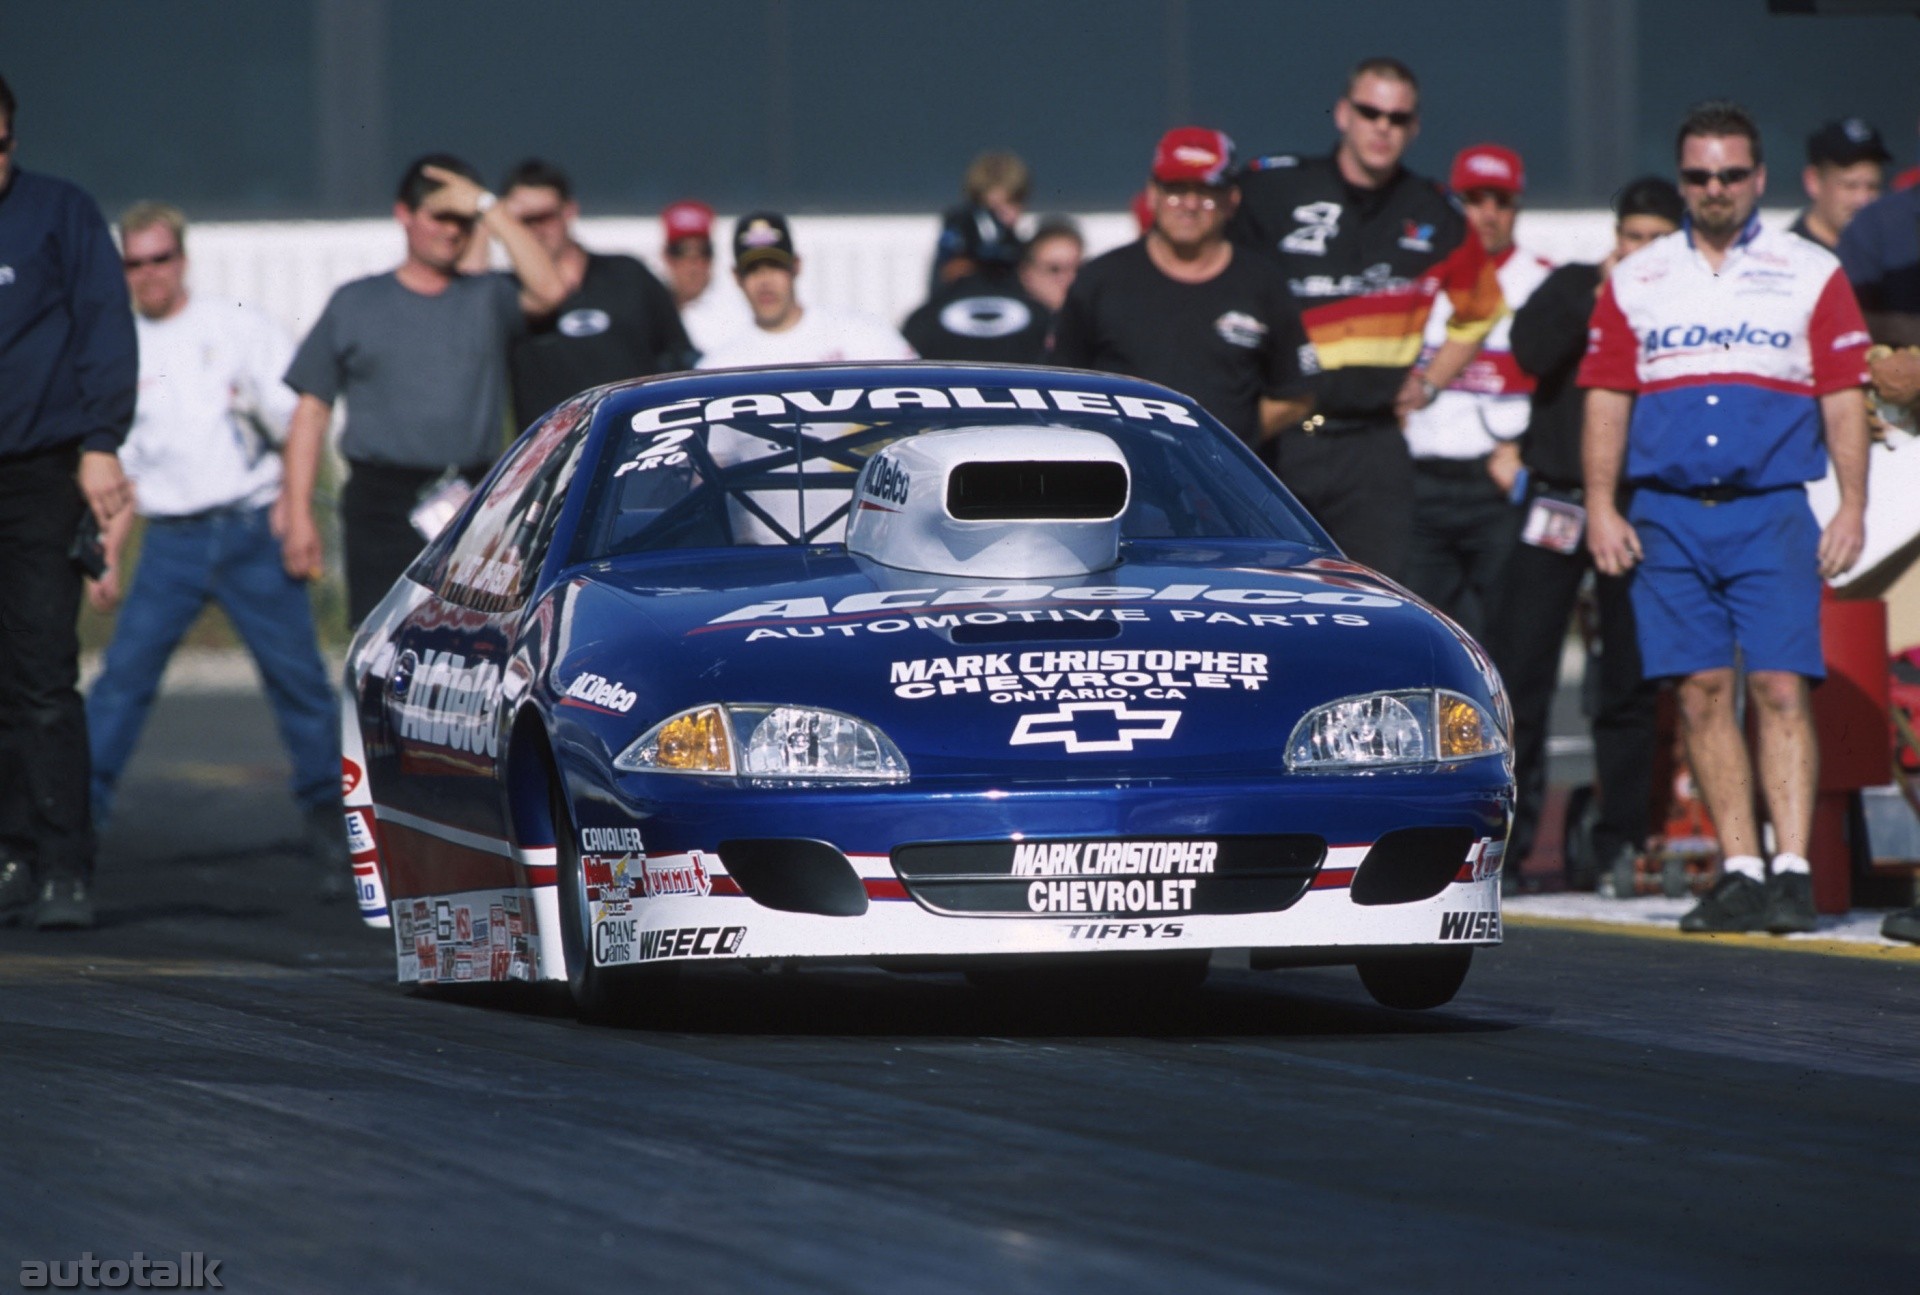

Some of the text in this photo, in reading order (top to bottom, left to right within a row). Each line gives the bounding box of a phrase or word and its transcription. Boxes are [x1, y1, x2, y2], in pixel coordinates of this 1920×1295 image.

[631, 387, 1199, 433] CAVALIER
[636, 428, 694, 460] 2
[613, 451, 688, 478] PRO
[863, 454, 910, 505] ACDelco
[707, 584, 1402, 625] ACDelco
[745, 608, 1370, 642] AUTOMOTIVE PARTS
[890, 650, 1269, 684] MARK CHRISTOPHER
[565, 671, 637, 713] ACDelco
[894, 672, 1269, 700] CHEVROLET
[990, 687, 1187, 704] ONTARIO, CA
[582, 827, 644, 851] CAVALIER
[1011, 841, 1217, 876] MARK CHRISTOPHER
[1027, 879, 1196, 912] CHEVROLET
[640, 926, 747, 960] WISECO
[1064, 923, 1184, 939] TIFFYS
